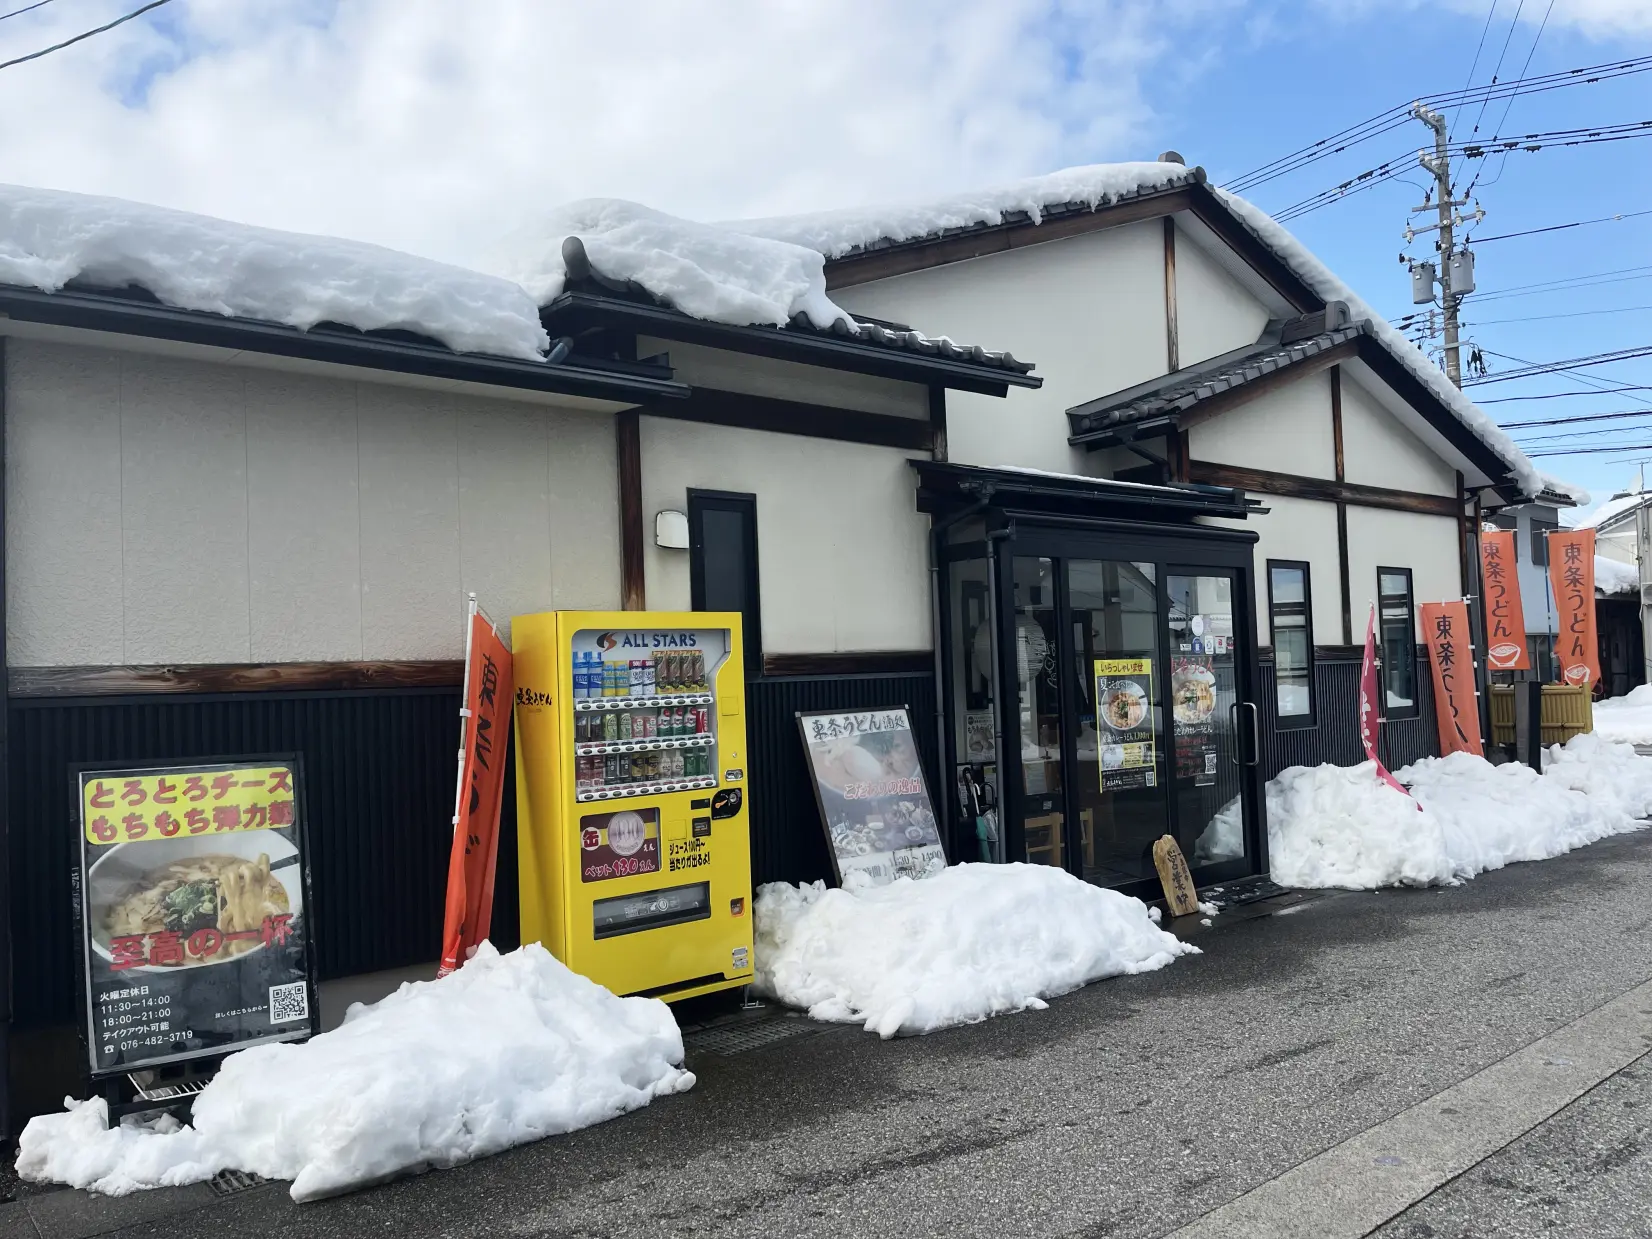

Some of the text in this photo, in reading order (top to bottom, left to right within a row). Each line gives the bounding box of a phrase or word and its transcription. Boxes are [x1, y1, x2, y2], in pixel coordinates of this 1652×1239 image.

[1483, 541, 1511, 638] 東条うどん
[1562, 543, 1588, 657] 東条うどん
[622, 631, 697, 648] ALL STARS
[1100, 662, 1143, 673] いらっしゃいませ
[844, 777, 922, 800] こだわりの逸品
[583, 829, 600, 848] 缶
[110, 913, 294, 972] 至高の一杯
[100, 985, 149, 1002] 火曜定休日
[103, 1021, 170, 1041] テイクアウト可能
[120, 1030, 193, 1051] 076-482-3719
